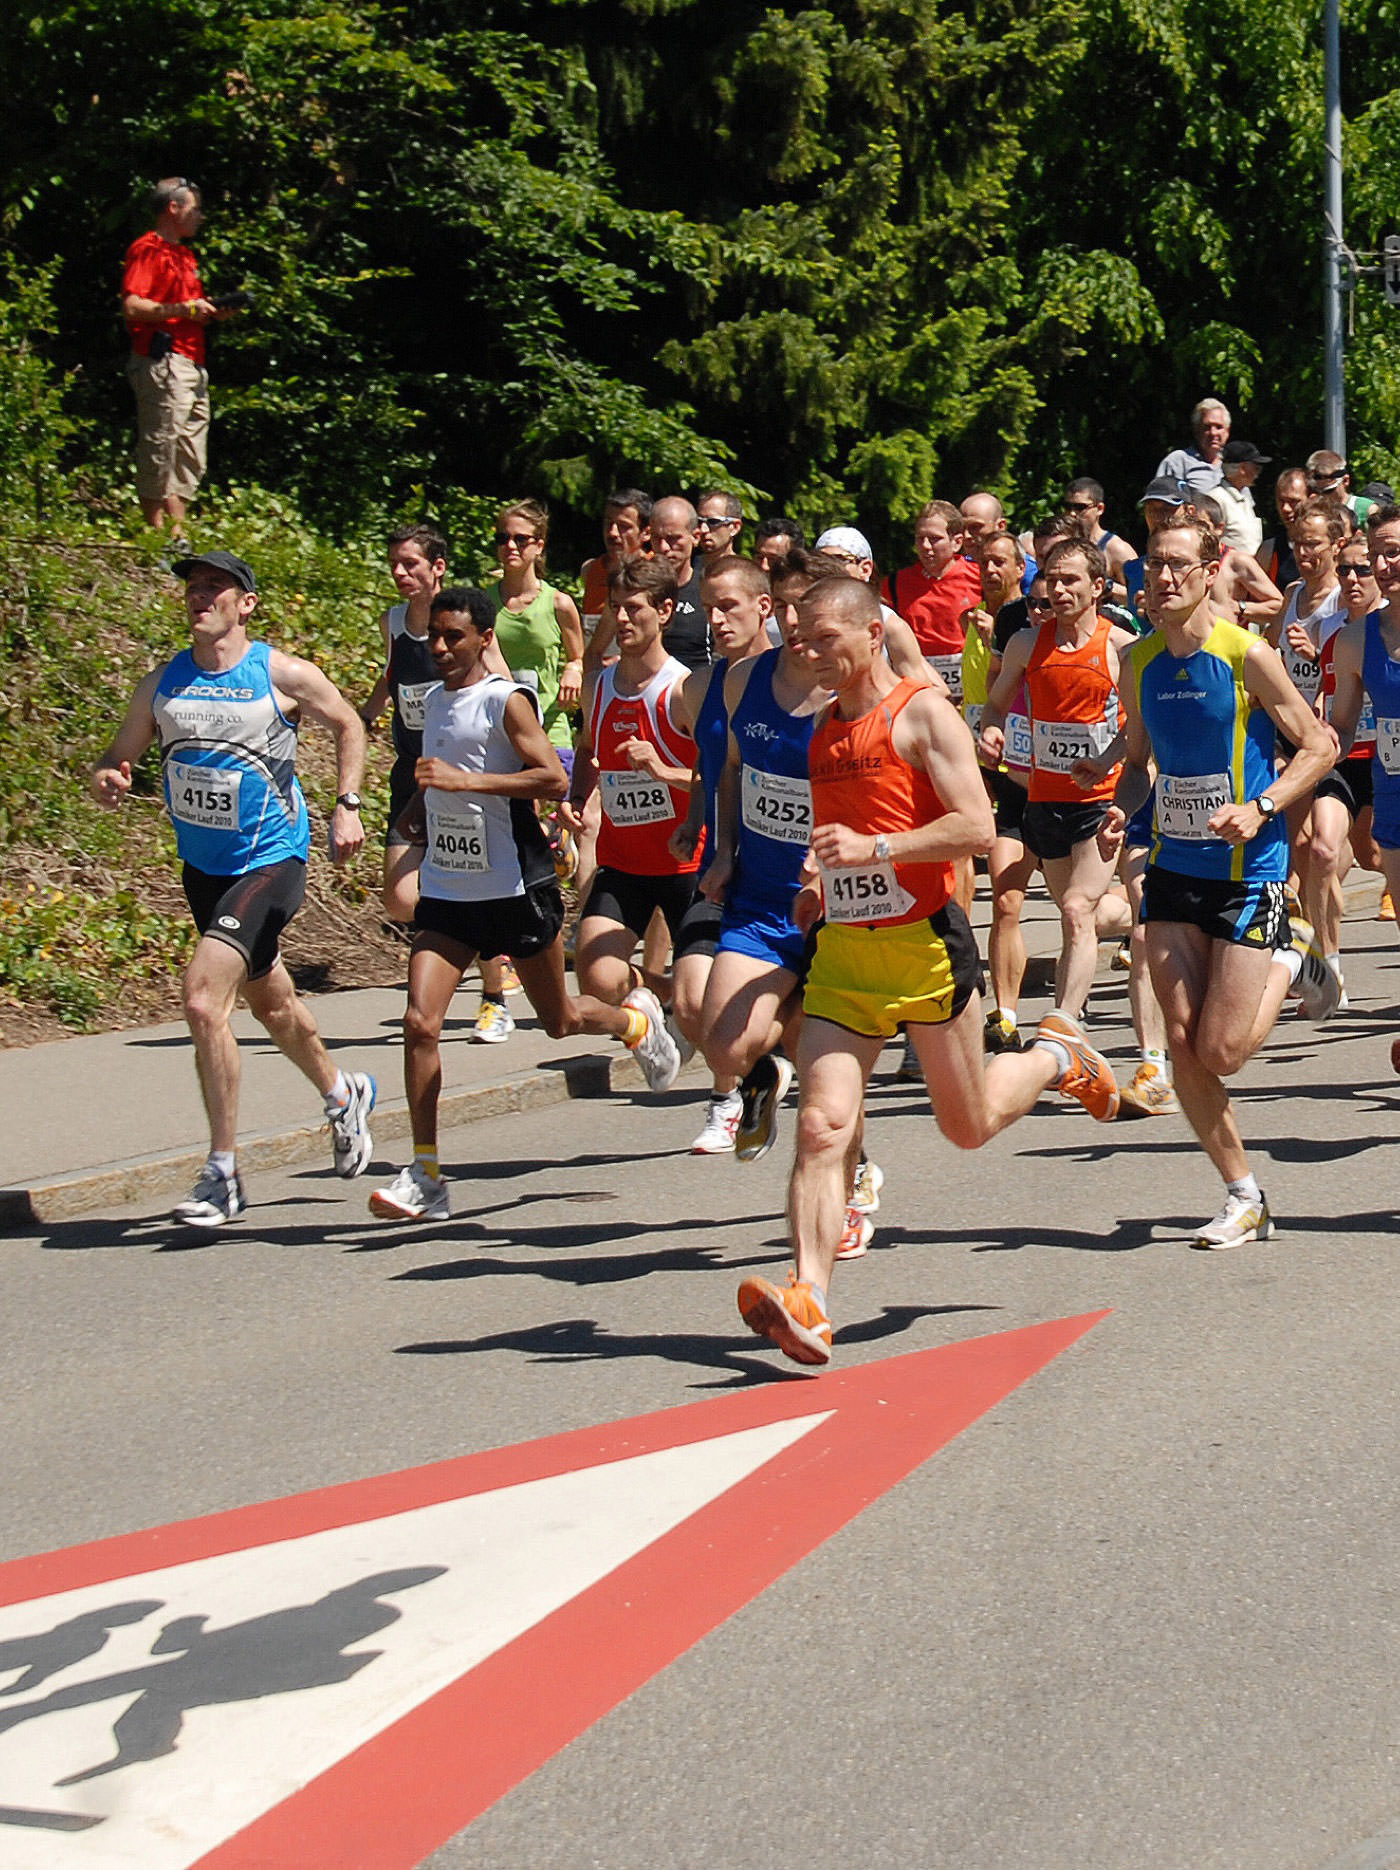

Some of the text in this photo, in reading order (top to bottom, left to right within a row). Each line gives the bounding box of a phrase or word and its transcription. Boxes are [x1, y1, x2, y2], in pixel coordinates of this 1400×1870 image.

[171, 686, 254, 700] BROOKS
[174, 710, 224, 725] running
[1048, 741, 1090, 759] 4221
[1384, 753, 1390, 762] B
[183, 787, 232, 812] 4153
[616, 789, 666, 810] 4128
[1162, 795, 1225, 810] CHRISTIAN
[756, 796, 810, 825] 4252
[1163, 813, 1194, 826] A 1
[787, 829, 808, 841] 2010
[436, 834, 481, 855] 4046
[833, 873, 889, 901] 4158
